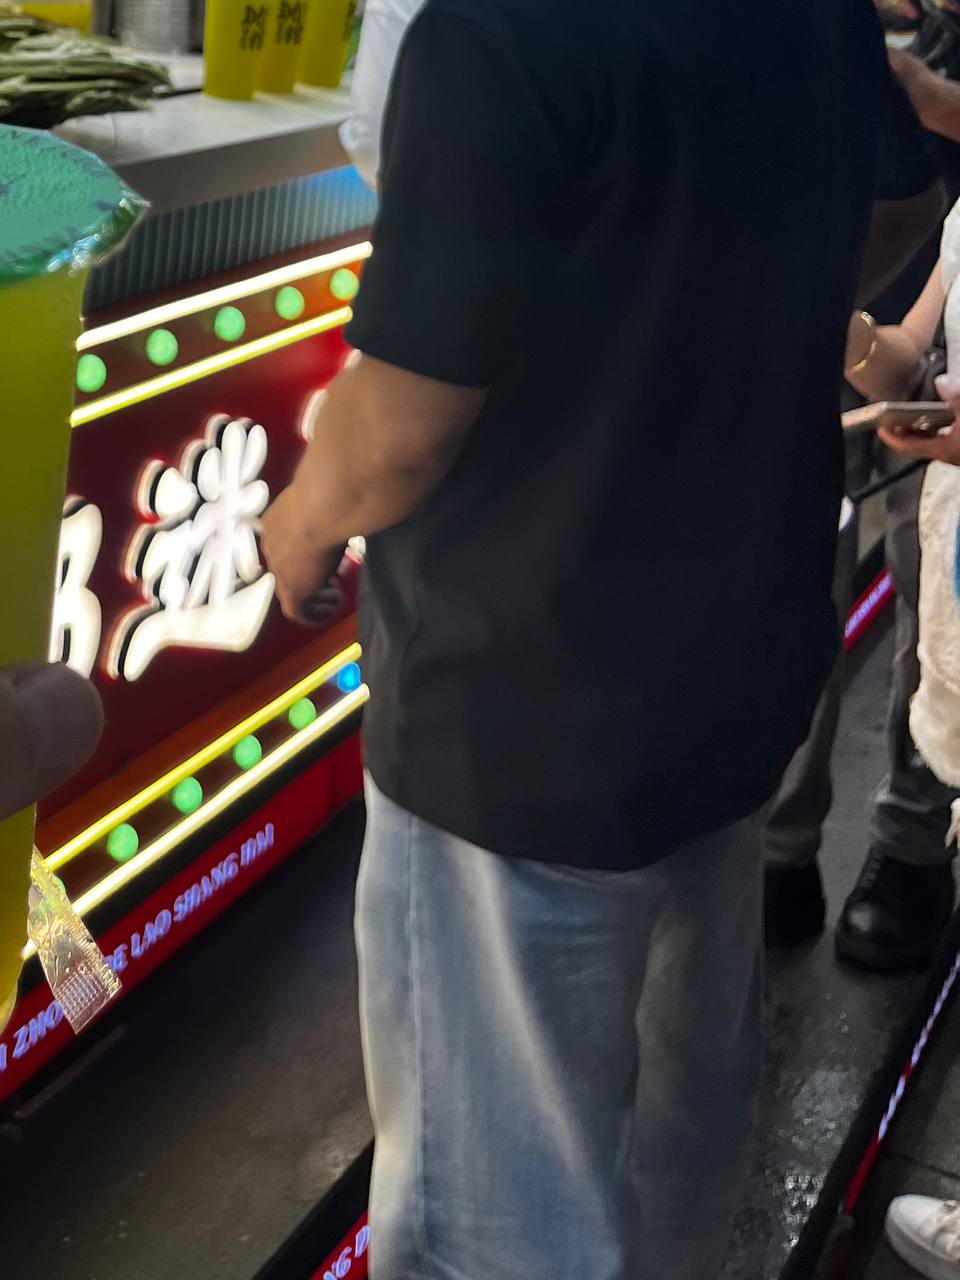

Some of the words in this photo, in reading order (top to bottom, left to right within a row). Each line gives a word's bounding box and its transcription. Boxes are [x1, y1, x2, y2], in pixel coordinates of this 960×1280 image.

[12, 1000, 64, 1060] ZHO
[130, 908, 172, 959] LAO
[172, 851, 239, 923] SHANG
